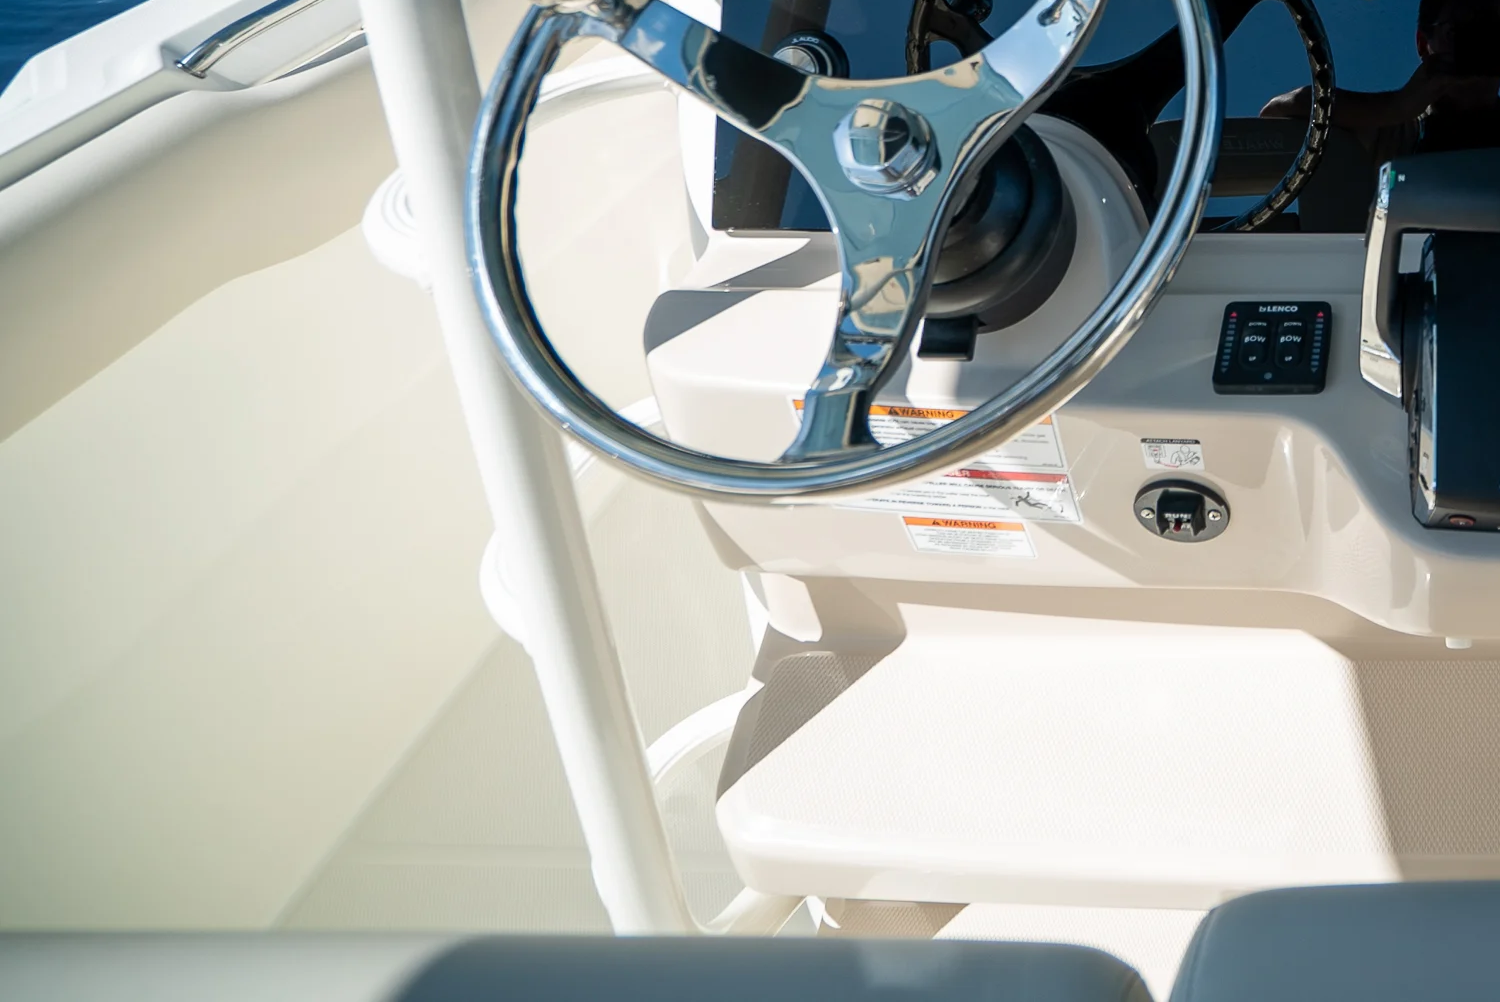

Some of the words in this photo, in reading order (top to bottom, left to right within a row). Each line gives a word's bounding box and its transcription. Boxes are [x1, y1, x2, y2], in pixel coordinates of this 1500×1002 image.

[798, 36, 820, 44] AUDIO
[1267, 305, 1298, 313] LENCO
[1244, 335, 1266, 343] BOW
[1280, 335, 1302, 343] BOW
[901, 408, 954, 418] WARNING
[941, 519, 996, 529] WARNING
